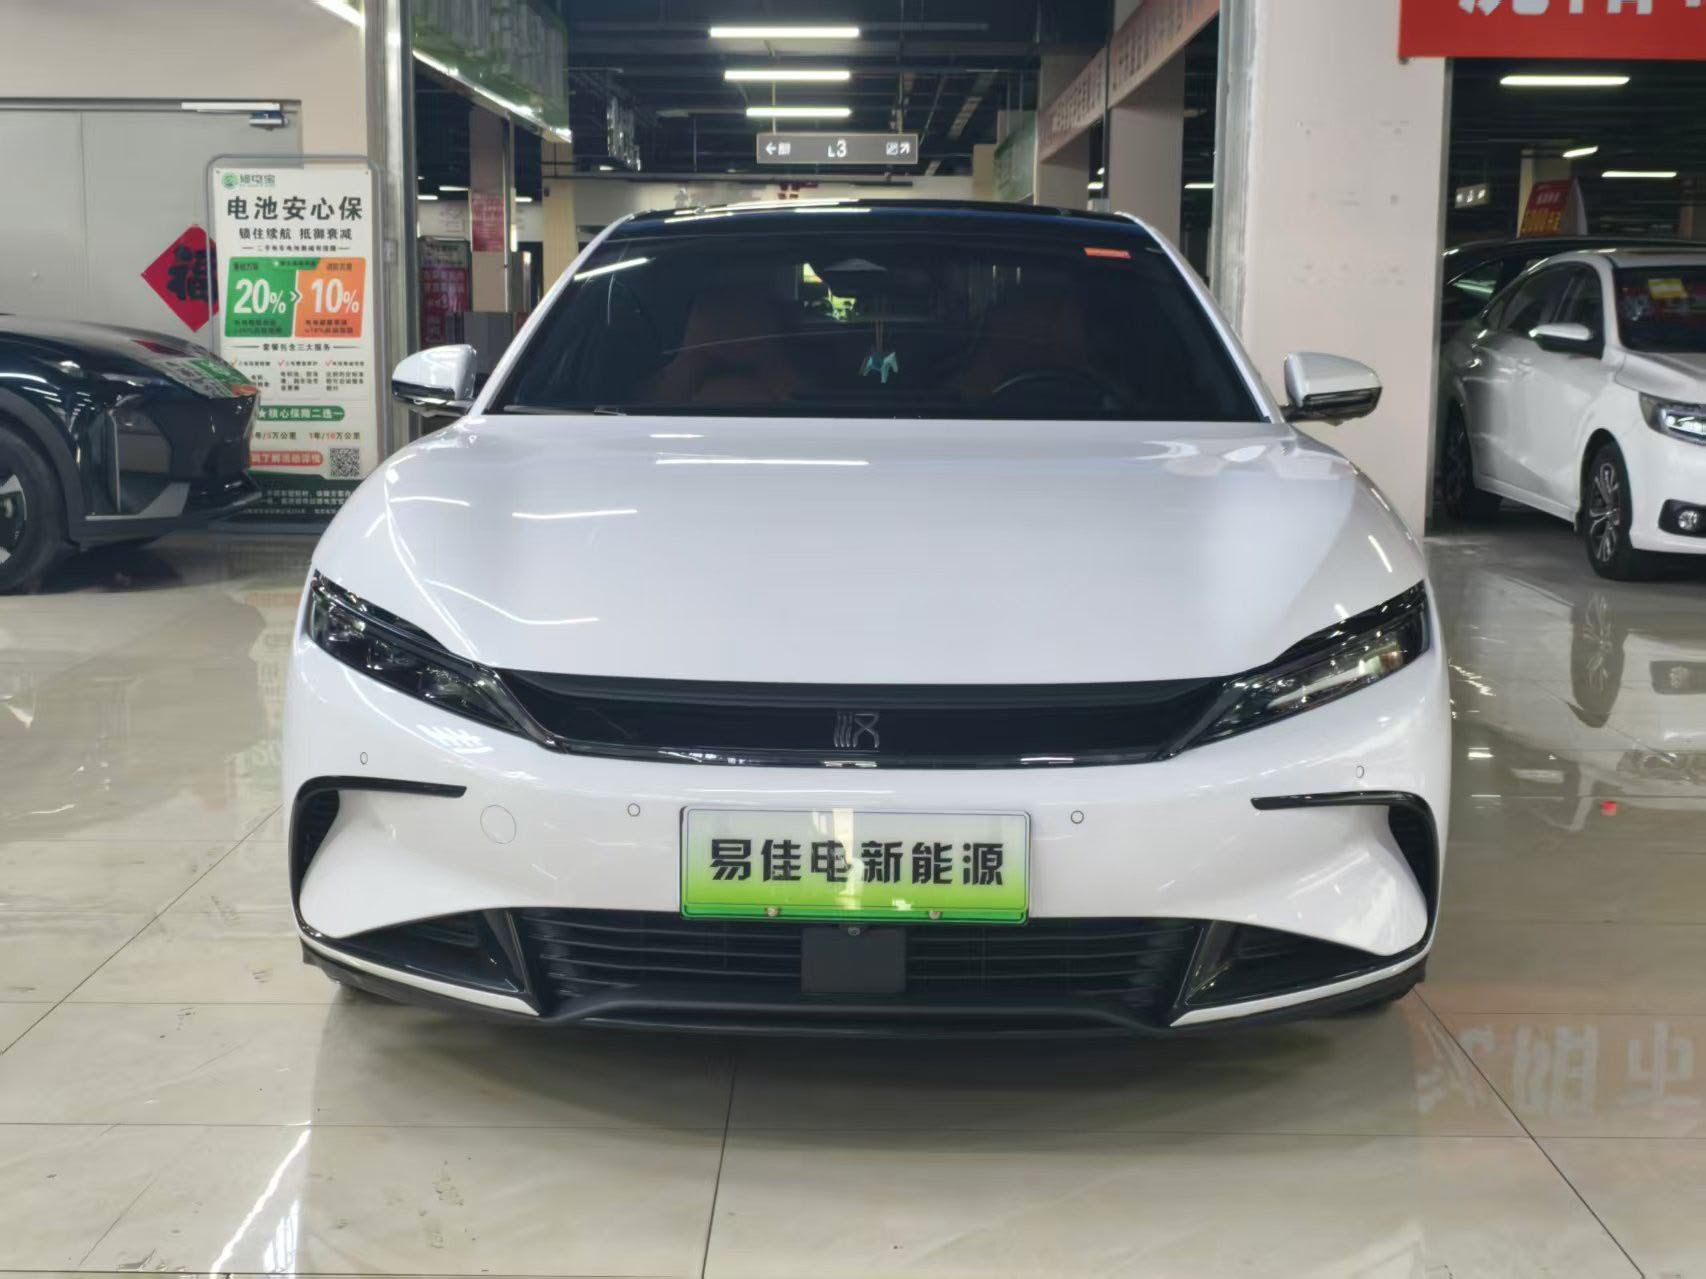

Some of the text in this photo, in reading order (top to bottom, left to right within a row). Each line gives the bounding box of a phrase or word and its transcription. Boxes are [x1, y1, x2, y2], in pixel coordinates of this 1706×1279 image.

[827, 139, 848, 158] L3
[227, 195, 362, 221] 电池安心保
[239, 228, 352, 240] 锁住续航 抵御衰减
[233, 278, 287, 314] 20%
[311, 278, 360, 314] 10%
[268, 408, 343, 419] 核心保障二选一
[709, 838, 1004, 886] 易佳电新能源
